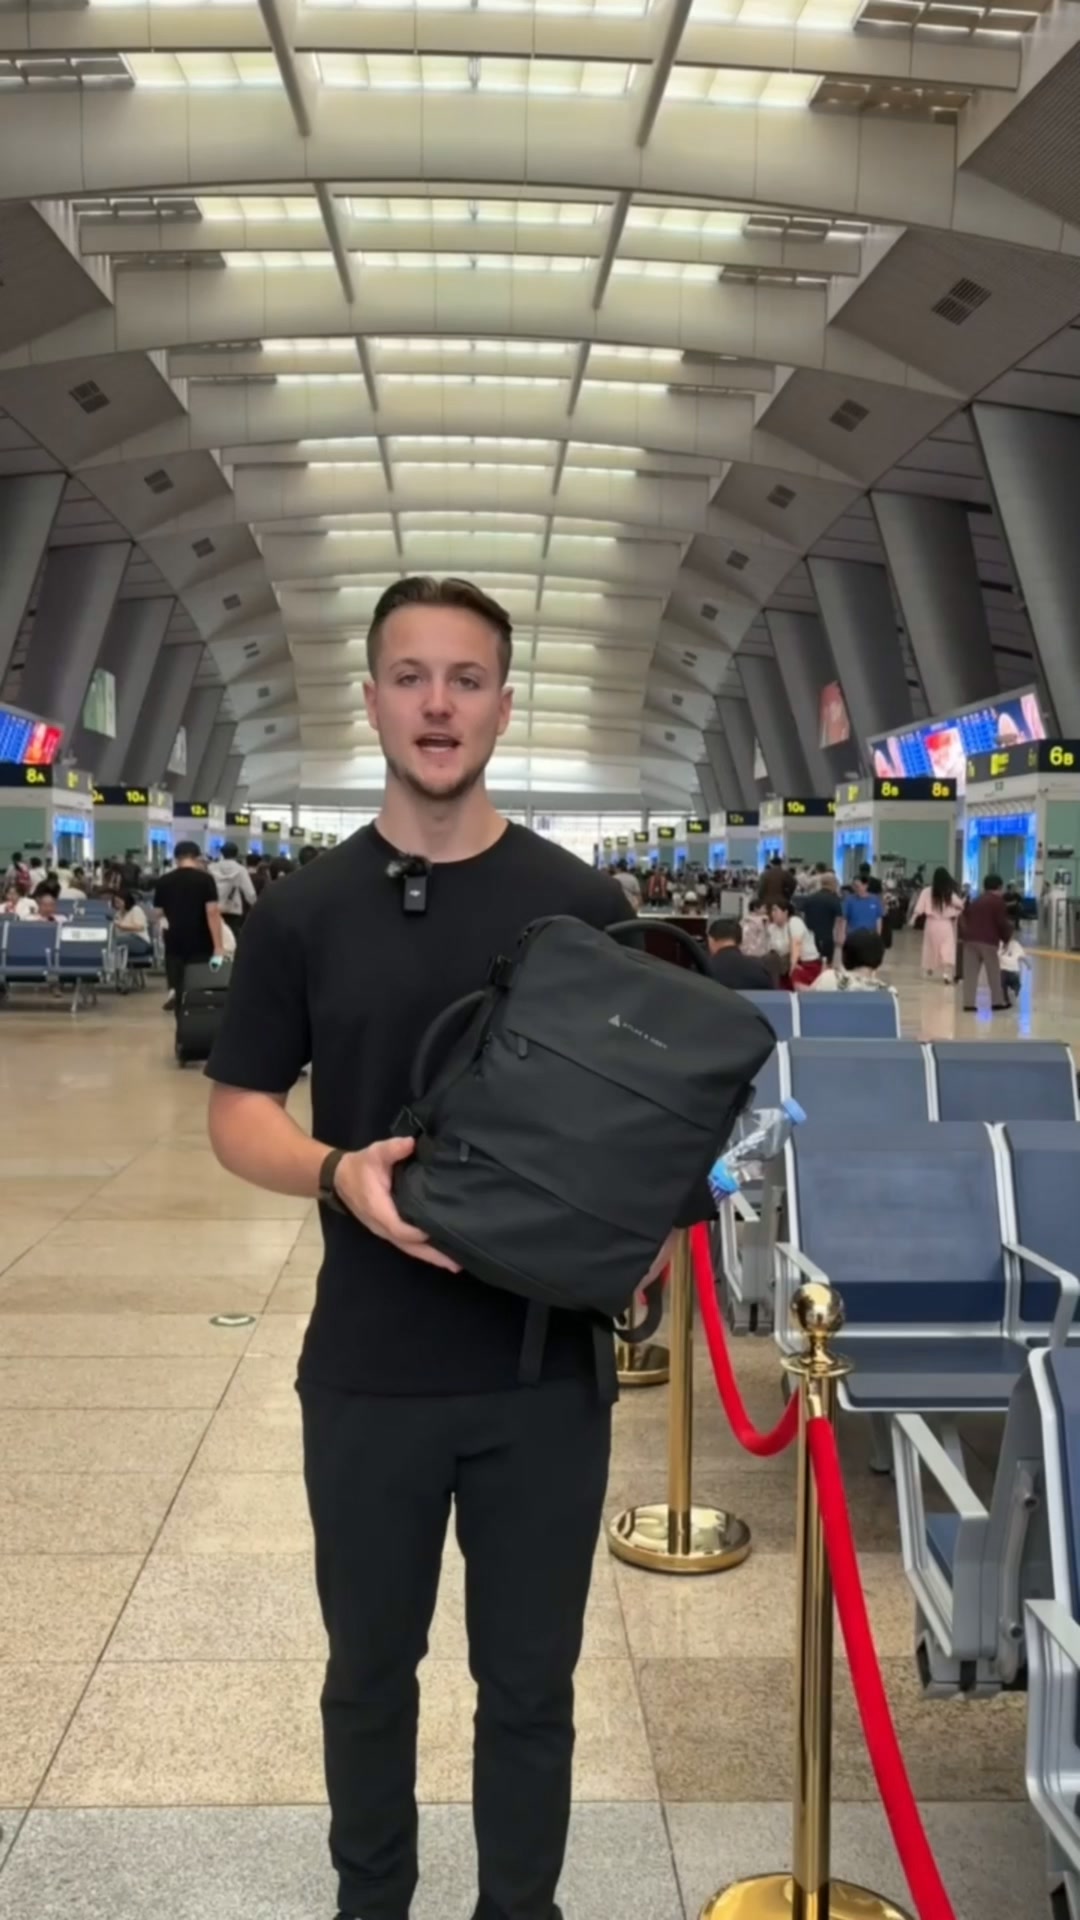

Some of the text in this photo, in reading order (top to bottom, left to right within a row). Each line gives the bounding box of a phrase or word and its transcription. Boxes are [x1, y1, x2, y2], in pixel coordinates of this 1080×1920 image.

[1050, 746, 1074, 766] 6B
[26, 768, 46, 783] 8A
[126, 790, 146, 803] 10A
[881, 782, 950, 797] 8B 8B
[787, 801, 806, 813] 10B
